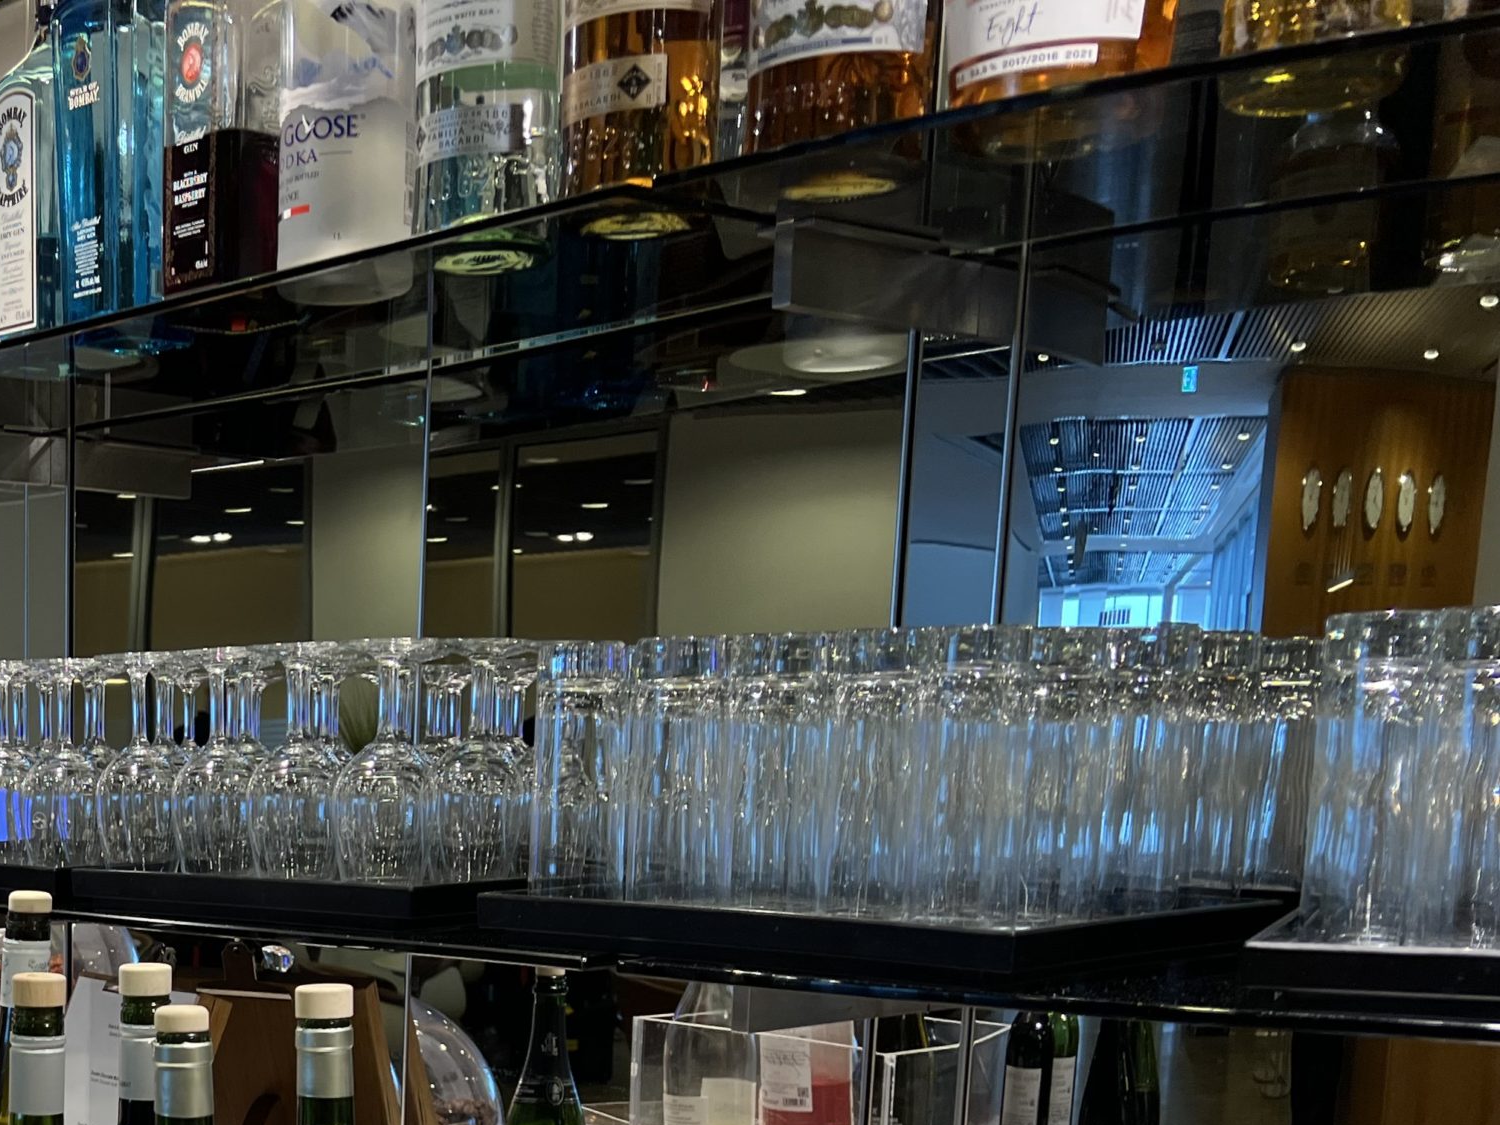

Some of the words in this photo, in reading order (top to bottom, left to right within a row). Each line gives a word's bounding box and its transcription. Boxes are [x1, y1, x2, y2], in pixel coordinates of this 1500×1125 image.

[177, 21, 209, 51] BOMBAY
[284, 113, 358, 147] GOOSE
[183, 142, 199, 155] GIN
